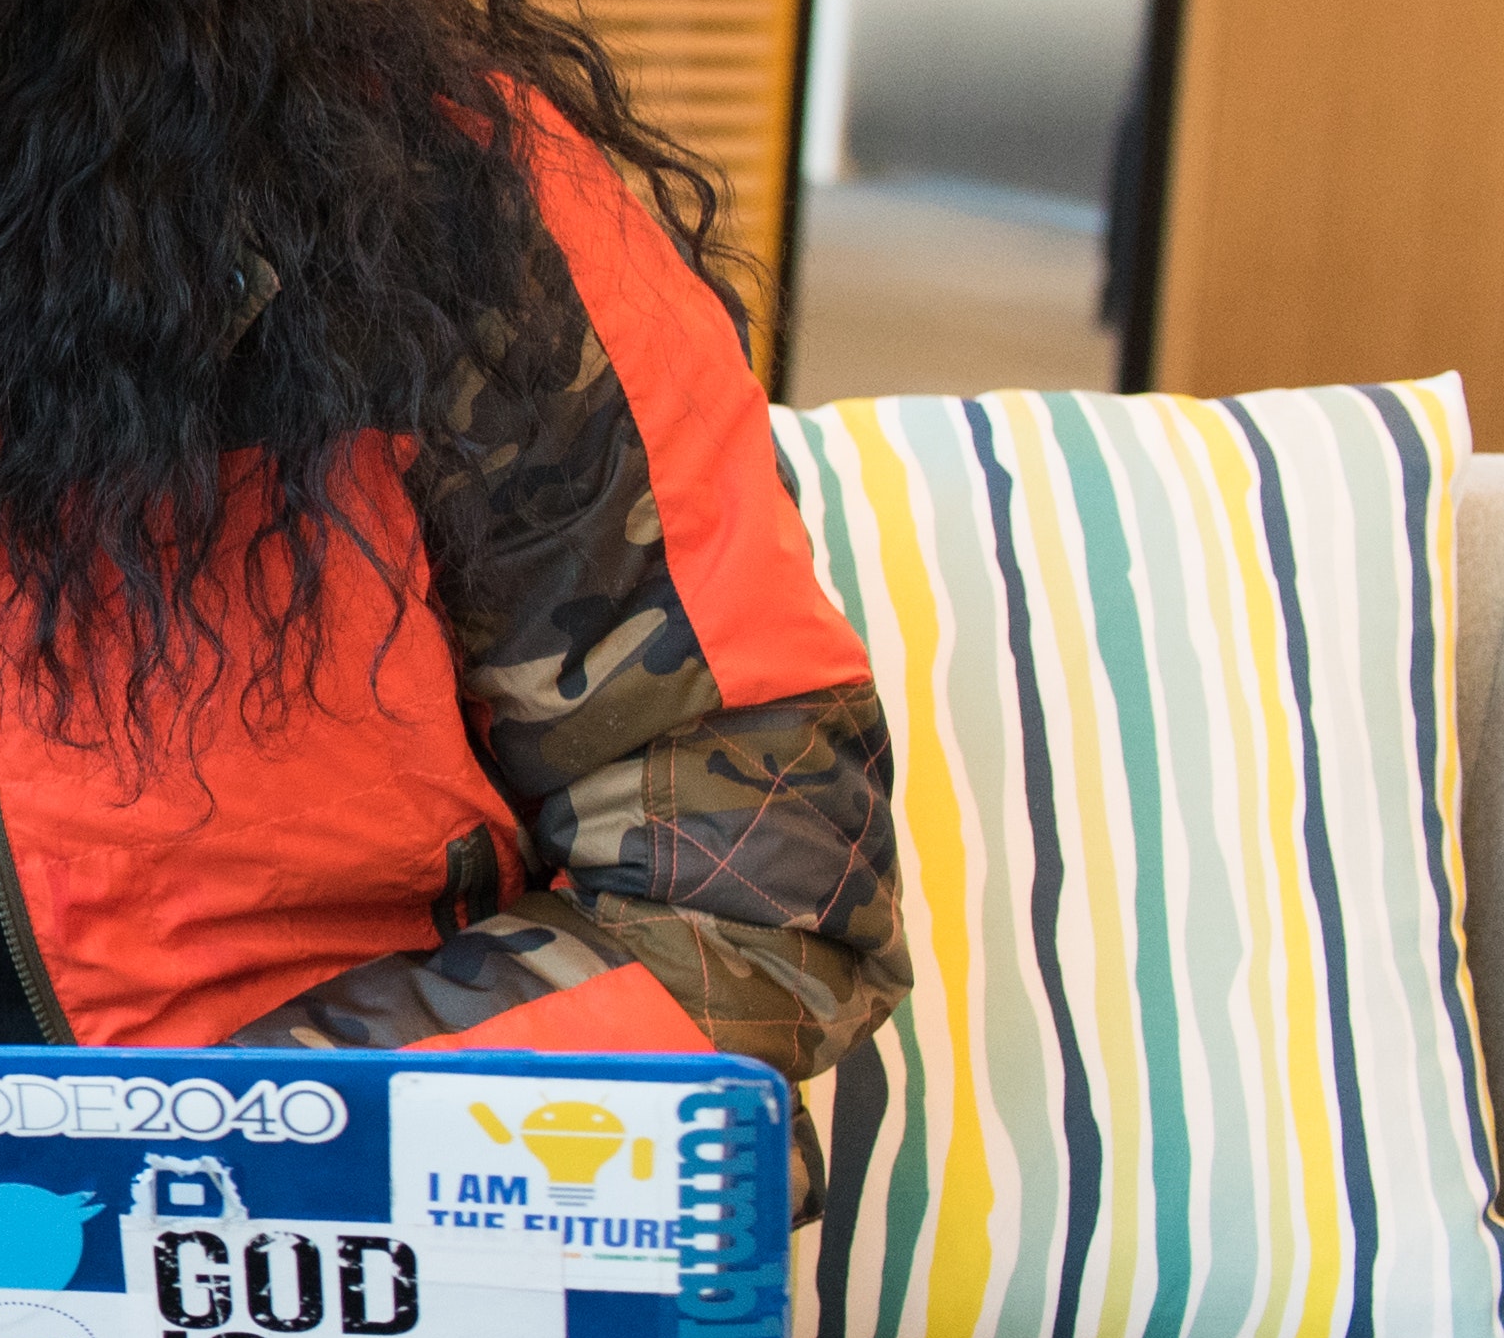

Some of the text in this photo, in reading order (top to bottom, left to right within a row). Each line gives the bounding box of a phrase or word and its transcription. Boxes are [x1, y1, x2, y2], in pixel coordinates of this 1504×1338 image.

[428, 1172, 528, 1205] I AM
[153, 1230, 419, 1336] GOD
